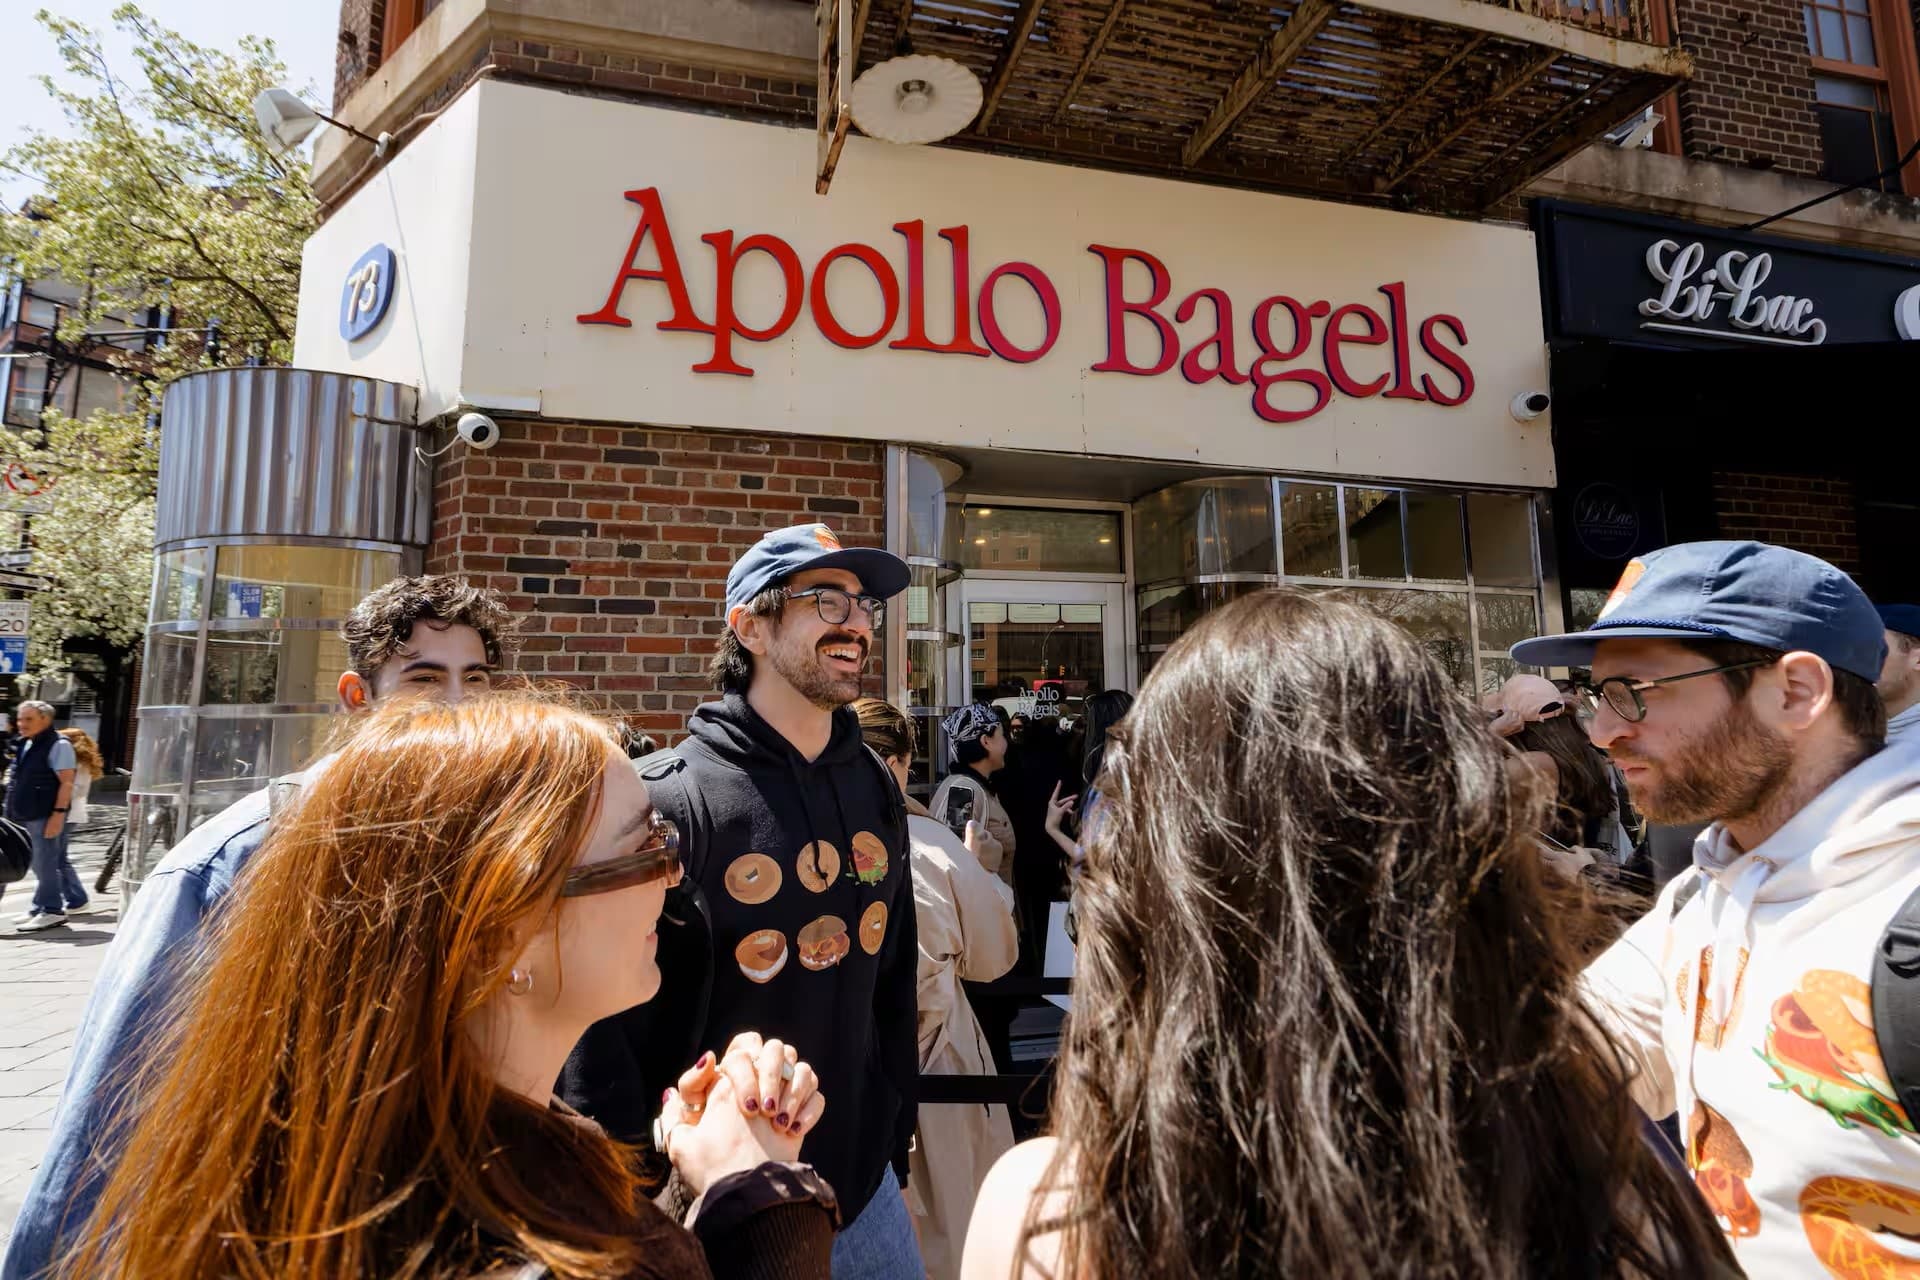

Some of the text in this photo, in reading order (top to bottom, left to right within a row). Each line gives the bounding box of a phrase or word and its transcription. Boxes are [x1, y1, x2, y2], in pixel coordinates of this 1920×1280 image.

[347, 260, 379, 323] 73
[576, 187, 1475, 423] Apollo Bagels
[1638, 239, 1827, 345] Li-Lac
[0, 619, 25, 632] 20
[1017, 701, 1060, 720] Bagels
[1019, 687, 1060, 703] Apollo
